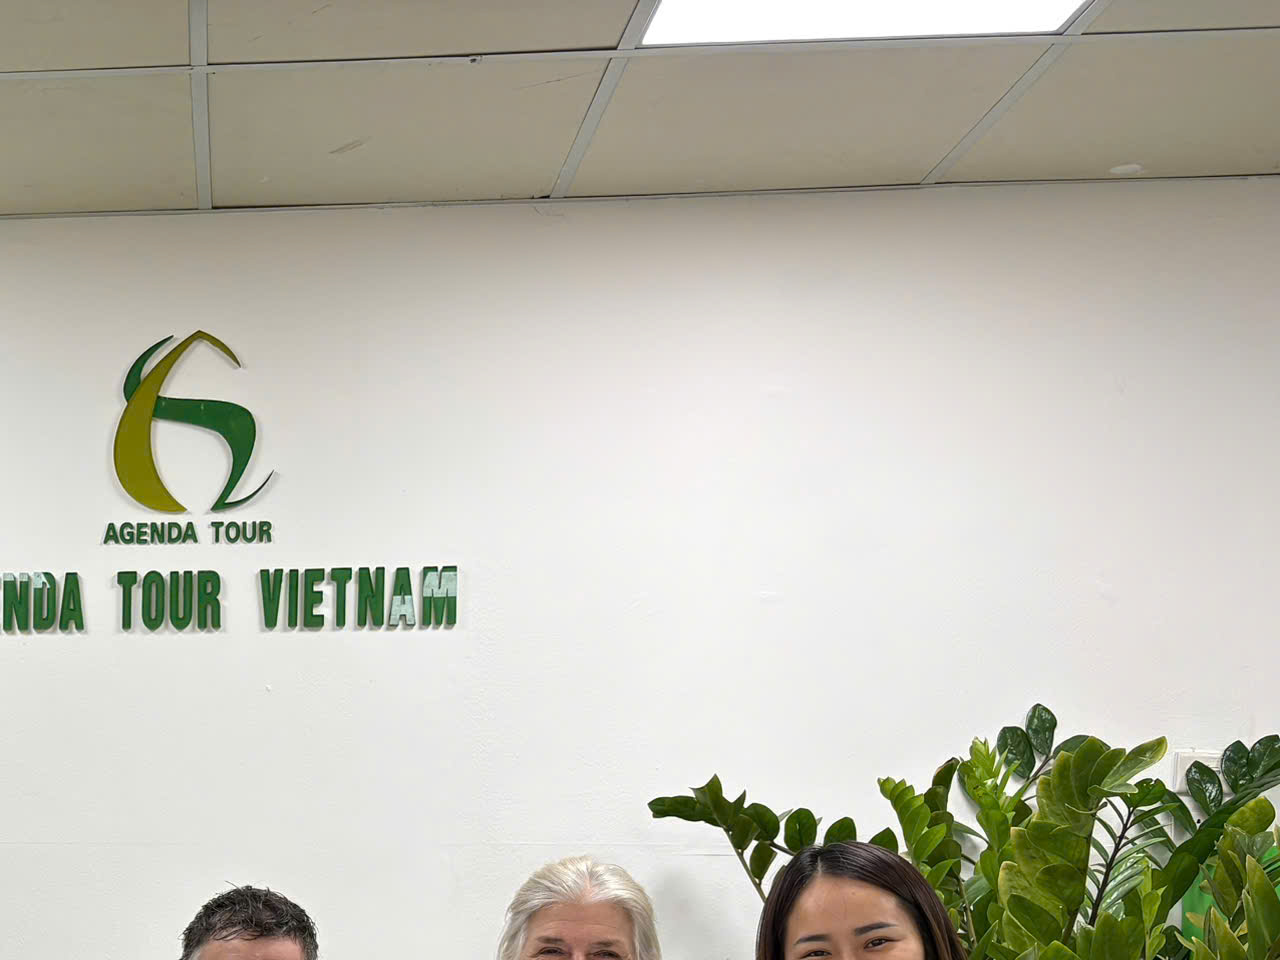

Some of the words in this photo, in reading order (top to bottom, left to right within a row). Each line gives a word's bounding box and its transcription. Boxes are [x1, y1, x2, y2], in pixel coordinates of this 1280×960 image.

[103, 521, 198, 545] AGENDA
[211, 521, 272, 543] TOUR
[116, 570, 222, 632] TOUR
[259, 565, 458, 630] VIETNAM
